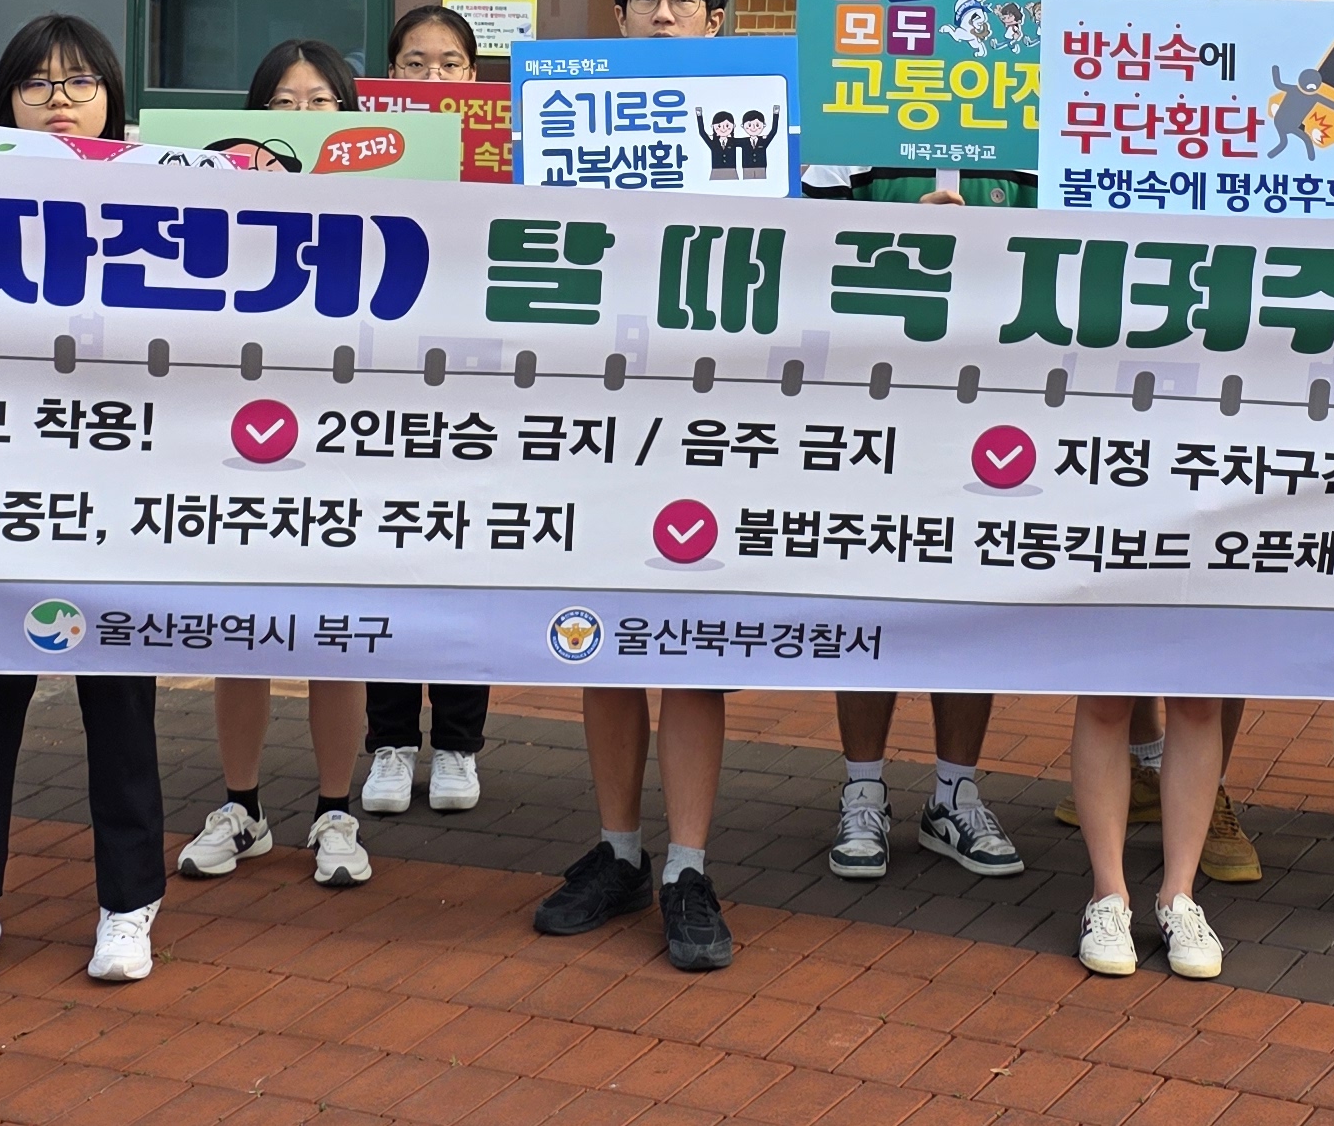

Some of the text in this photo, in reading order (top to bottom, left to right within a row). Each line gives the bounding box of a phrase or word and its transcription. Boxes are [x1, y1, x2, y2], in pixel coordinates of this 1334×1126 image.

[840, 10, 931, 51] 모두
[525, 59, 610, 76] 매곡고등학교
[1063, 30, 1236, 82] 방심속에
[539, 89, 688, 138] 슬기로운
[1060, 101, 1265, 160] 무단횡단
[327, 142, 353, 166] 잘
[540, 140, 689, 190] 교복생활
[899, 142, 997, 162] 매곡고등학교
[1059, 167, 1207, 211] 불행속에
[485, 218, 615, 325] 탈
[656, 224, 787, 336] 때
[830, 230, 958, 342] 꼭
[33, 398, 154, 452] 착용!
[315, 408, 499, 462] 2인탑승
[517, 415, 618, 464] 금지
[681, 419, 779, 469] 음주
[799, 424, 897, 475] 금지
[1053, 436, 1151, 487] 지정
[130, 493, 363, 548] 지하주차장
[377, 499, 471, 550] 주차
[486, 501, 576, 552] 금지
[734, 507, 955, 564] 불법주차된
[973, 519, 1192, 572] 전동킥보드
[95, 611, 394, 653] 울산광역시 북구
[614, 617, 882, 660] 울산북부경찰서
